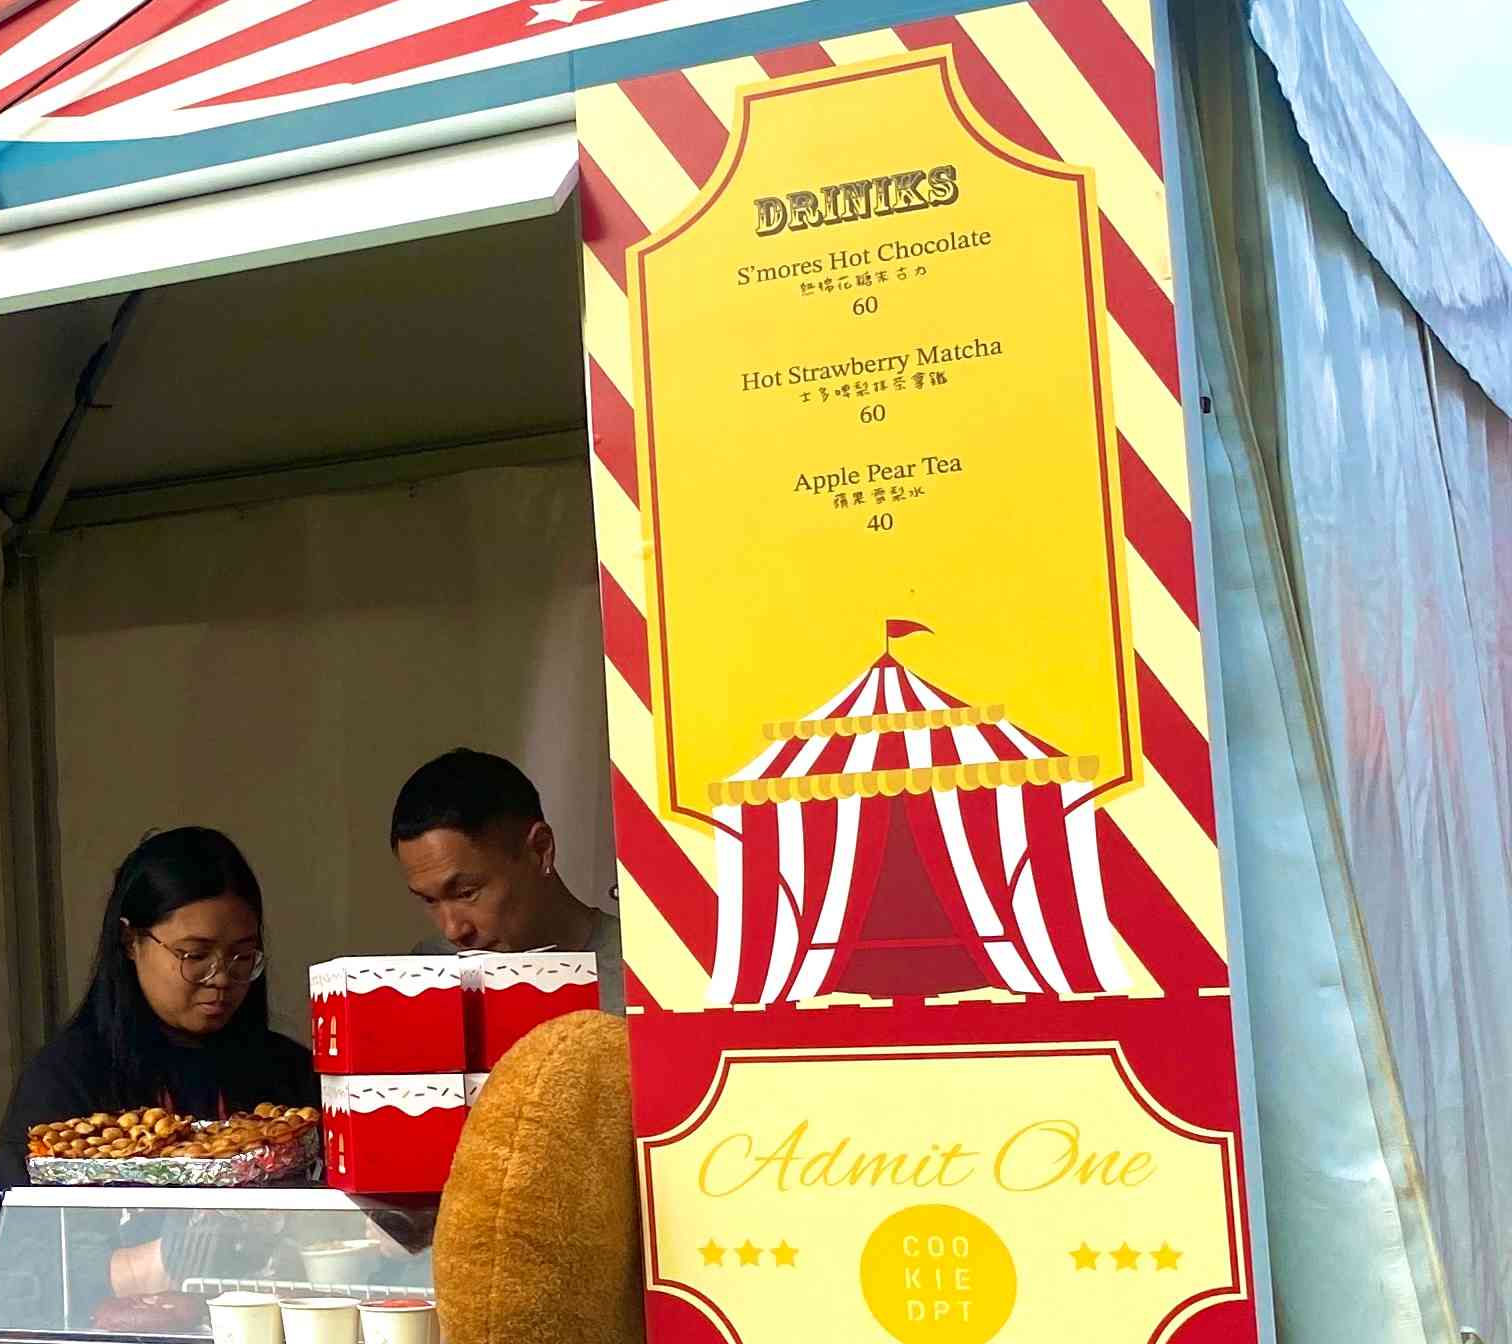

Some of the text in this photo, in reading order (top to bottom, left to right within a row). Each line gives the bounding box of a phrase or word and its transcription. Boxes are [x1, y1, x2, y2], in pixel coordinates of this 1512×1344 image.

[754, 165, 959, 237] DRINIKS
[738, 230, 992, 286] S'mores Hot Chocolate
[852, 296, 879, 316] 60
[741, 338, 1002, 391] Hot Strawberry Matcha
[860, 404, 886, 424] 60
[793, 456, 963, 495] Apple Pear Tea
[867, 513, 893, 532] 40
[698, 1119, 1157, 1197] Admit One
[903, 1235, 969, 1258] COO
[904, 1268, 972, 1291] KIE
[906, 1300, 973, 1322] DPT
